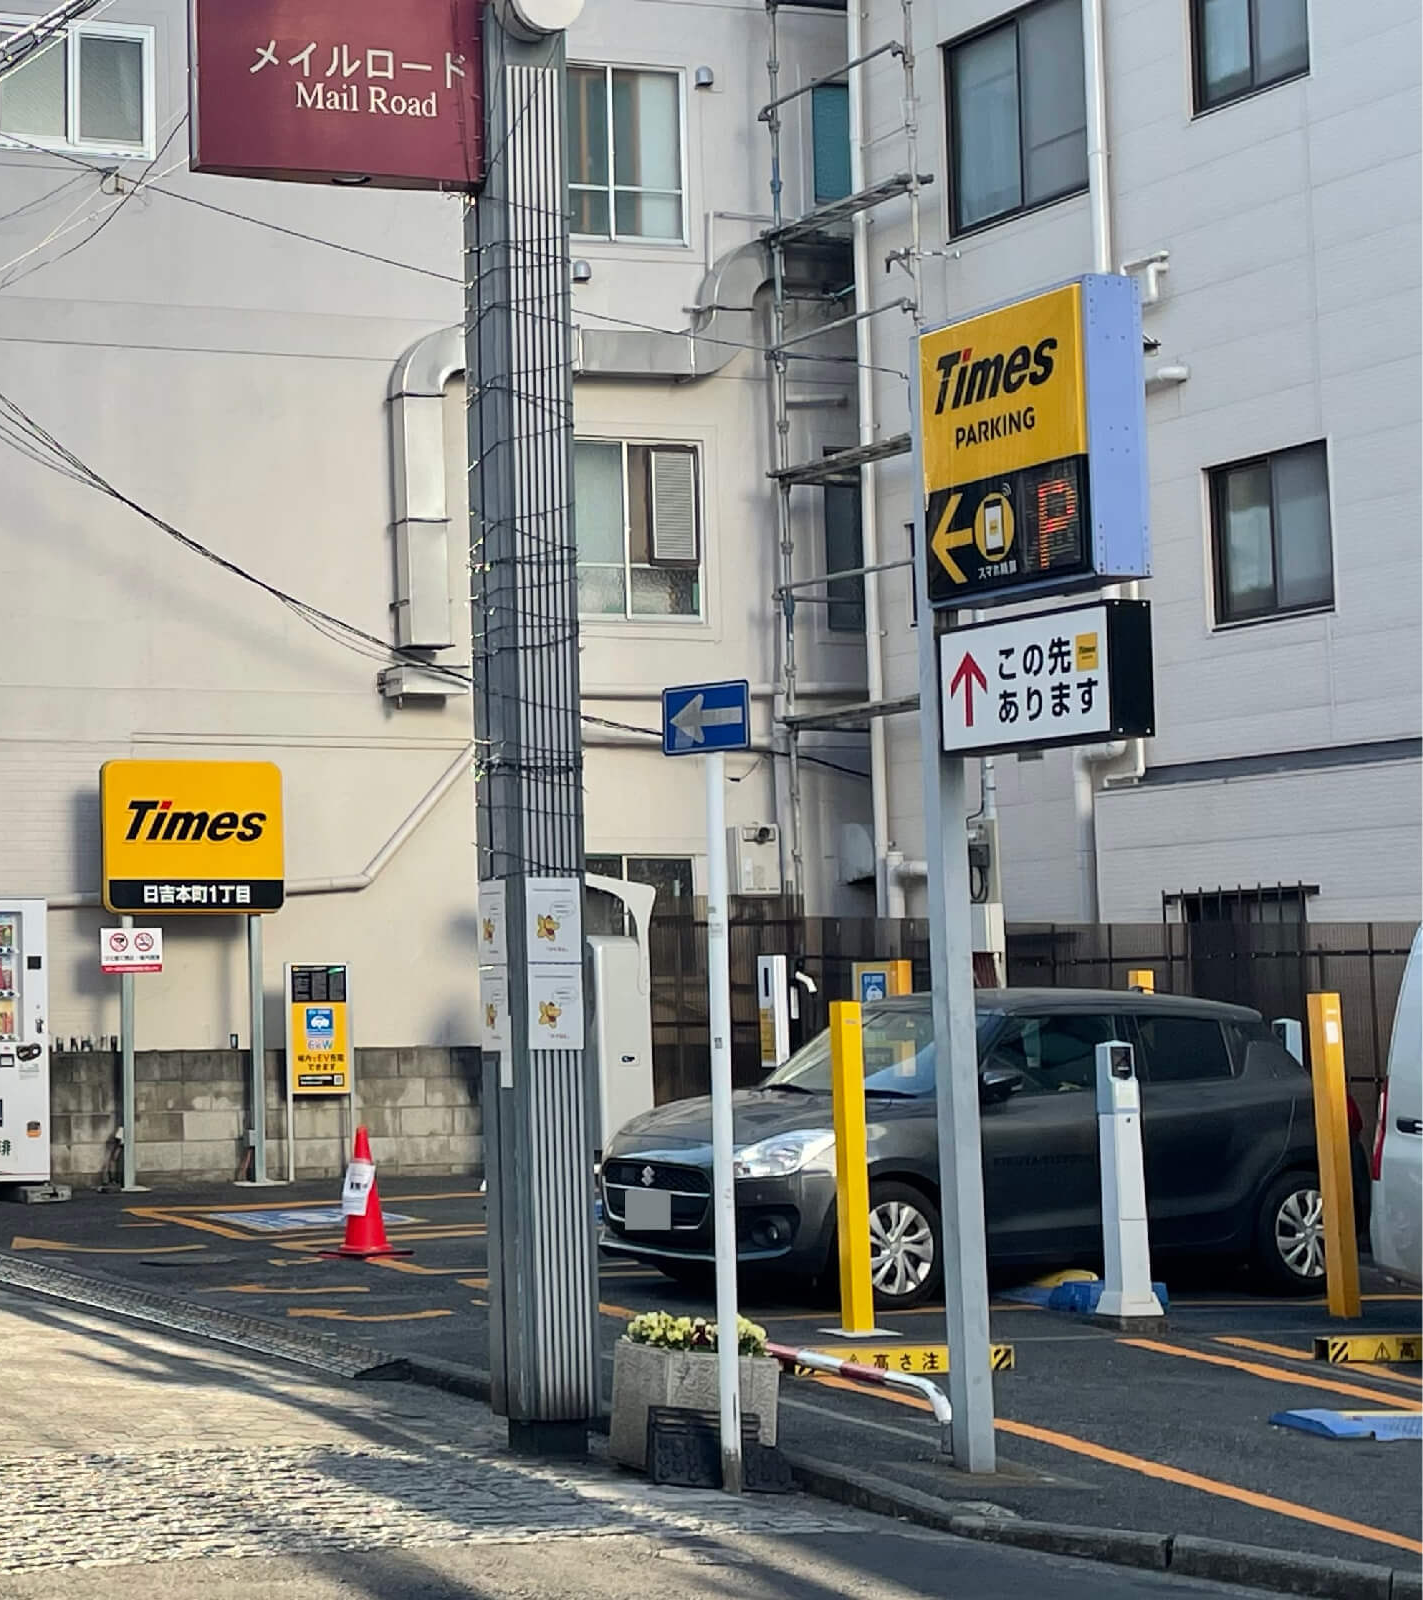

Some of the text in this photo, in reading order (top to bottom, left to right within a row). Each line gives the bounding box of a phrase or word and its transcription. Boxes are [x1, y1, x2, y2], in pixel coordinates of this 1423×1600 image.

[249, 39, 466, 89] メイルロード
[295, 81, 437, 117] Mail Road
[934, 337, 1057, 415] Times
[956, 406, 1036, 450] PARKING
[1038, 479, 1076, 569] P
[998, 636, 1071, 680] この先
[998, 677, 1098, 723] あります
[125, 800, 267, 842] Times
[143, 884, 251, 904] 日吉本町1丁目
[873, 1352, 939, 1371] 高さ注
